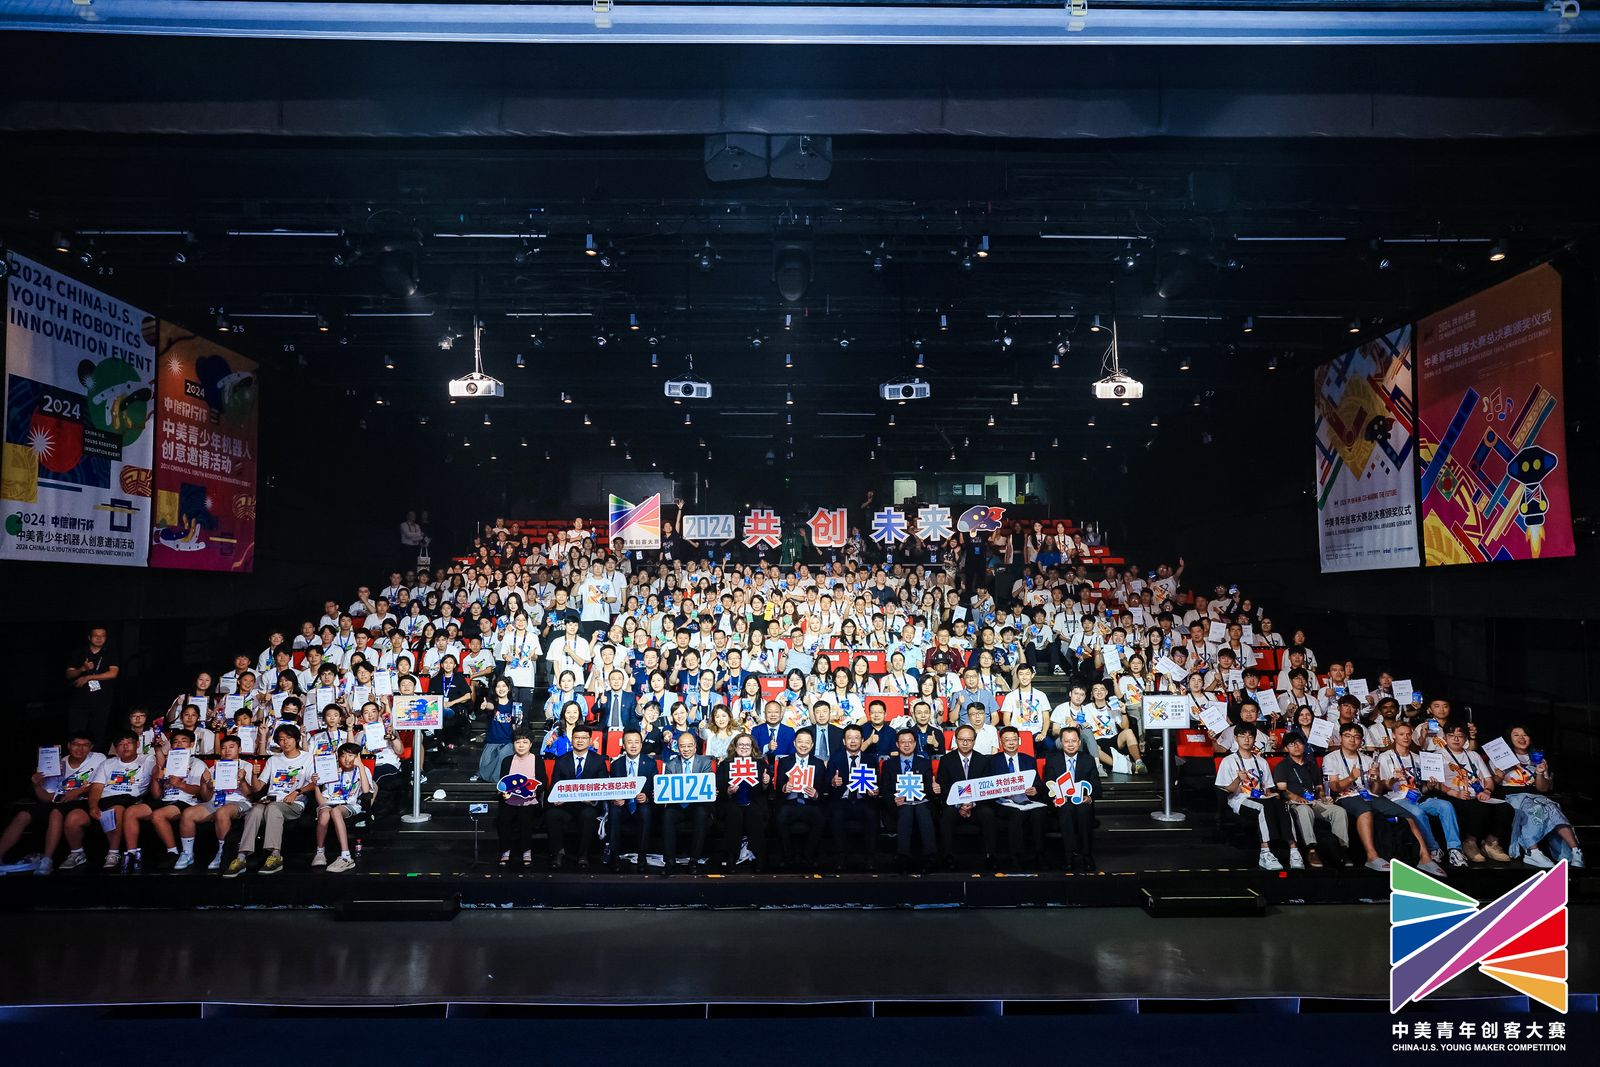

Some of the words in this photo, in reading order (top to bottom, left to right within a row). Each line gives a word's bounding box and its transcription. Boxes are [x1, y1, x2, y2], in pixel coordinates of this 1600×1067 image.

[10, 260, 51, 291] 2024
[57, 280, 133, 326] CHINA-U.S.
[11, 283, 68, 321] YOUTH
[73, 308, 141, 348] ROBOTICS
[11, 307, 107, 357] INNOVATION
[111, 345, 152, 373] EVENT
[185, 382, 205, 399] 2024
[42, 394, 81, 420] 2024
[162, 418, 252, 460] 中美青少年机器人
[161, 439, 232, 474] 创意邀请活动
[15, 511, 45, 526] 2024
[685, 516, 733, 538] 2024
[744, 510, 781, 547] 共
[809, 508, 846, 546] 创
[872, 508, 907, 542] 未
[917, 505, 953, 540] 来
[16, 529, 135, 550] 中美青少年机器人创意邀请活动
[730, 758, 759, 786] 共
[787, 765, 815, 792] 创
[848, 765, 878, 793] 未
[978, 780, 995, 790] 2024
[996, 775, 1025, 787] 共创未来
[557, 781, 637, 793] 中美青年创客大赛总决赛
[656, 774, 713, 802] 2024
[896, 772, 925, 801] 来
[979, 788, 1002, 797] CO-MAKING
[1002, 786, 1010, 794] THE
[1011, 784, 1026, 792] FUTURE
